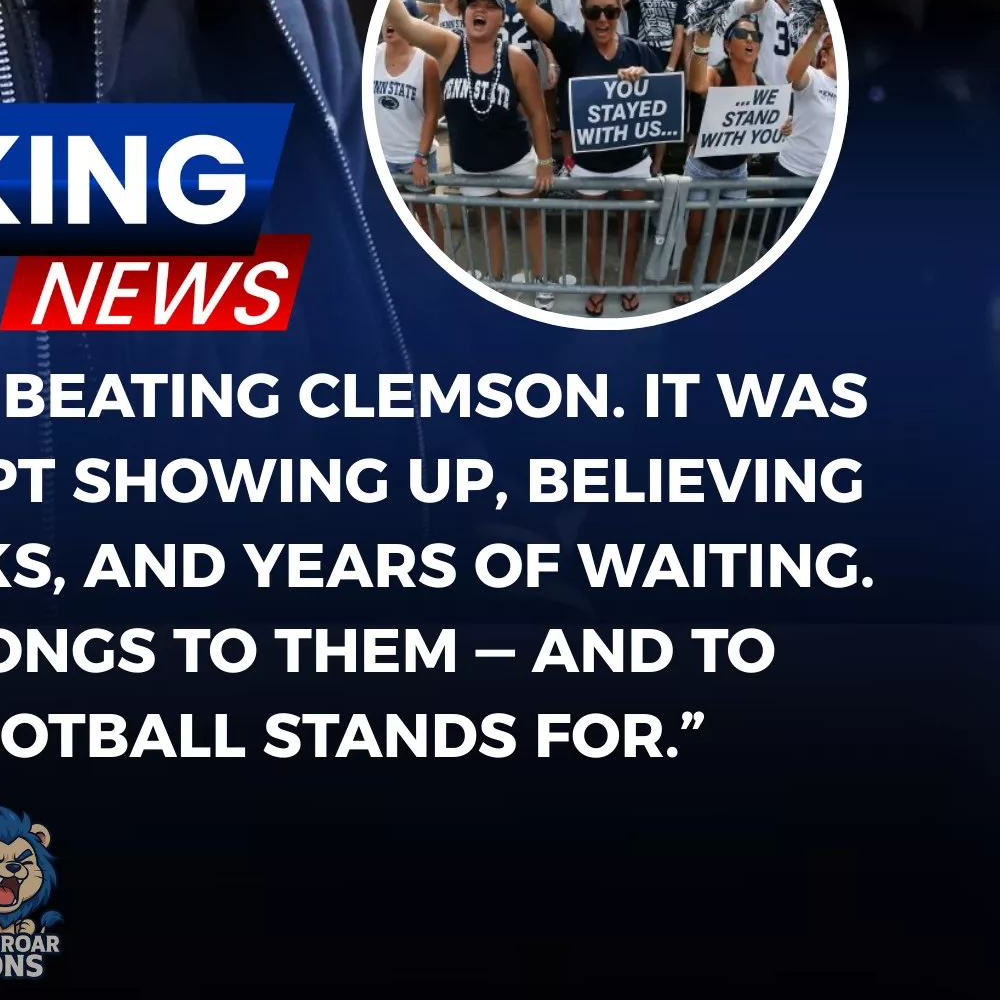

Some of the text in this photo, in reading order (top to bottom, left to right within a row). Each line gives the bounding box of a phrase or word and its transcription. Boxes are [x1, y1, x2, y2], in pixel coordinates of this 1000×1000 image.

[388, 80, 417, 101] STATE
[603, 79, 649, 99] YOU
[735, 89, 779, 107] ...WE
[587, 100, 667, 124] STAYED
[722, 109, 780, 128] STAND
[576, 118, 678, 146] WITH US...
[701, 131, 744, 149] WITH
